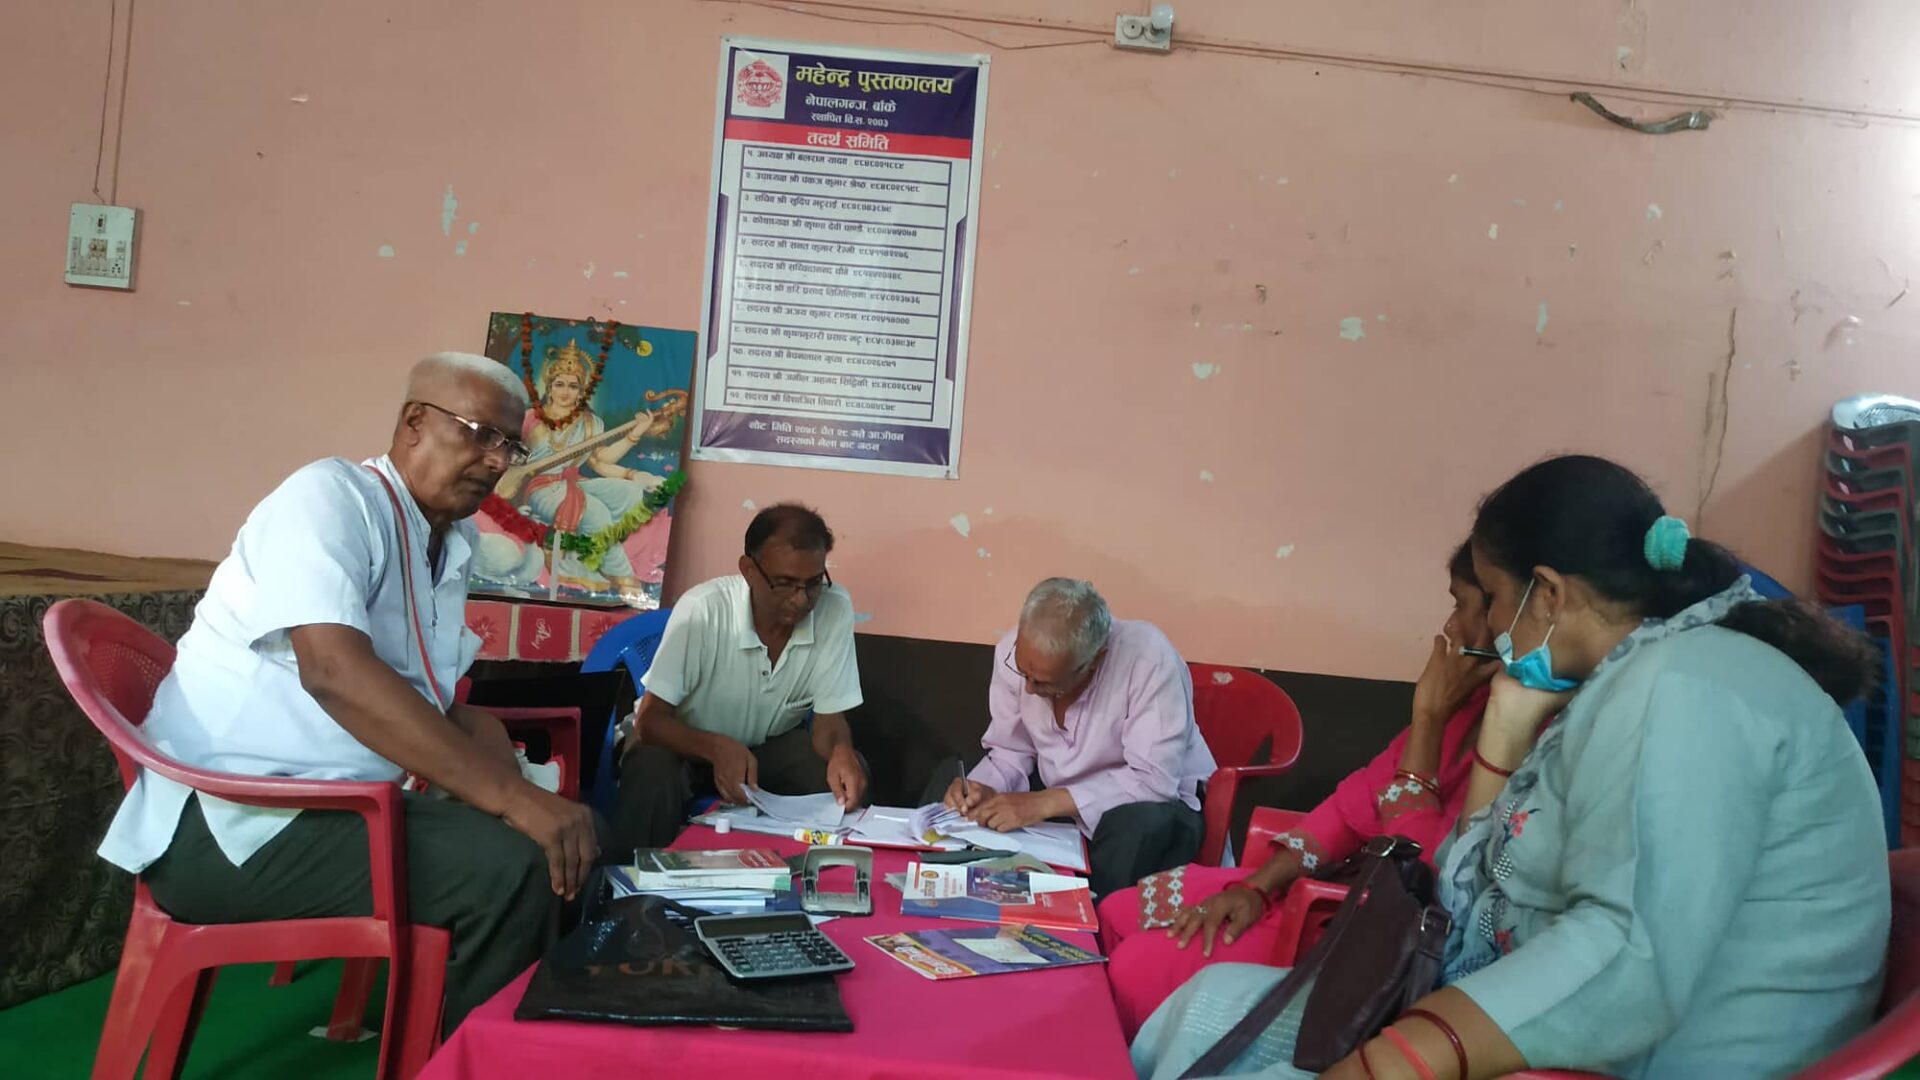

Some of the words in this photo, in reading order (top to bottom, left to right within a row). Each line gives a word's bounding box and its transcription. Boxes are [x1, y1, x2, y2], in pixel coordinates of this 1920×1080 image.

[795, 62, 852, 87] महेन्द्र
[857, 70, 954, 95] पुस्तकालय
[811, 111, 841, 122] स्थापित
[867, 118, 888, 127] २००३
[807, 129, 841, 146] तदर्थ
[845, 132, 889, 150] समिति
[786, 152, 795, 160] श्री
[798, 153, 824, 162] बलराम
[790, 173, 799, 183] श्री
[824, 178, 846, 187] कुमार
[777, 195, 786, 204] श्री
[792, 219, 801, 227] श्री
[828, 222, 841, 230] देवी
[751, 238, 775, 246] सदस्य
[811, 244, 833, 252] कुमार
[749, 260, 773, 269] सदस्य
[776, 262, 785, 270] श्री
[748, 282, 771, 290] सदस्य
[774, 284, 783, 292] श्री
[786, 284, 800, 293] हरि
[802, 286, 823, 294] प्रसाद
[746, 304, 770, 312] सदस्य
[773, 306, 782, 314] श्री
[809, 310, 830, 318] कुमार
[745, 326, 768, 334] सदस्य
[827, 332, 846, 340] प्रसाद
[747, 348, 771, 357] सदस्य
[774, 350, 783, 358] श्री
[747, 370, 770, 378] सदस्य
[773, 372, 782, 380] श्री
[745, 391, 768, 400] सदस्य
[771, 393, 780, 401] श्री
[771, 421, 791, 432] मिति
[868, 429, 904, 440] आजीवन
[775, 434, 815, 445] सदस्यको
